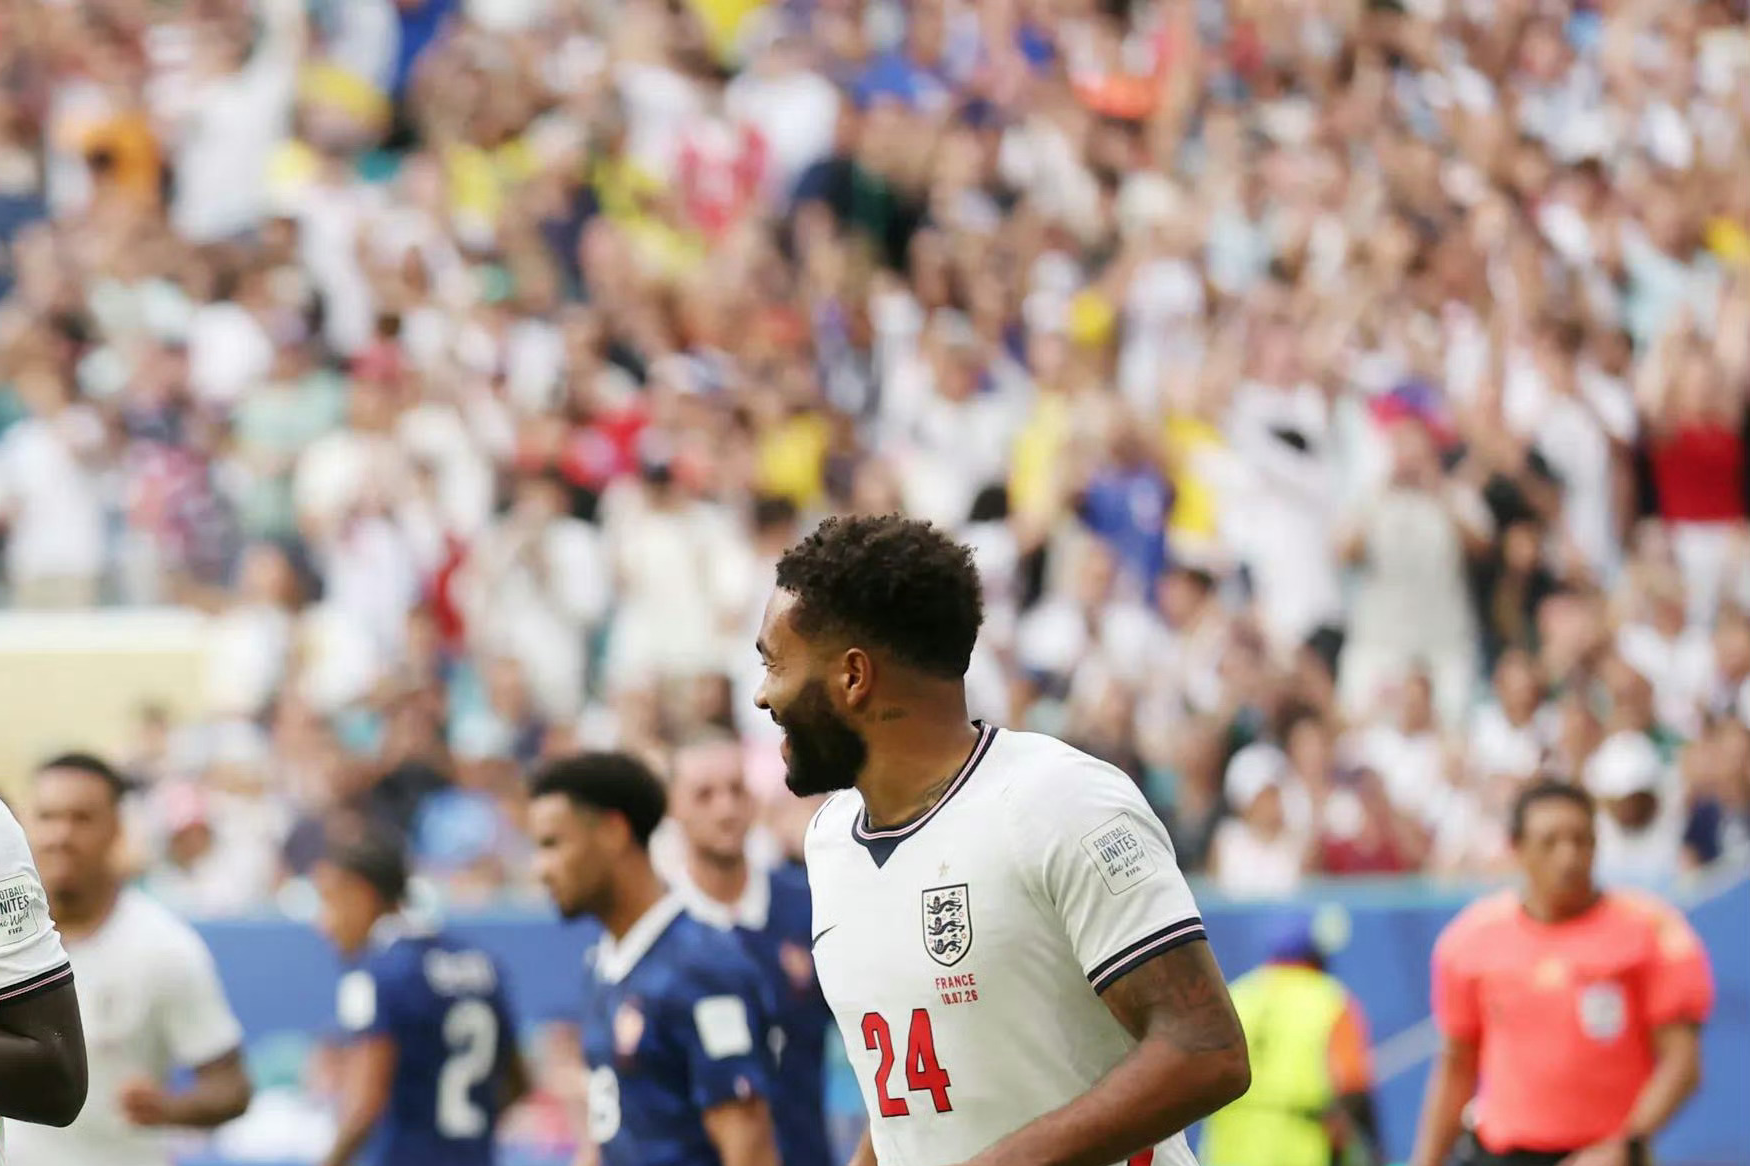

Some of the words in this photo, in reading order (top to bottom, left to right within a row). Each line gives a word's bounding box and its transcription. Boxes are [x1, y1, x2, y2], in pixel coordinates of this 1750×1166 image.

[1093, 823, 1130, 850] FOOTBALL
[1100, 833, 1137, 863] UNITES
[1107, 863, 1123, 877] the
[1125, 865, 1141, 877] FIFA
[8, 926, 23, 935] FIFA
[935, 973, 976, 990] FRANCE
[861, 1007, 953, 1117] 24
